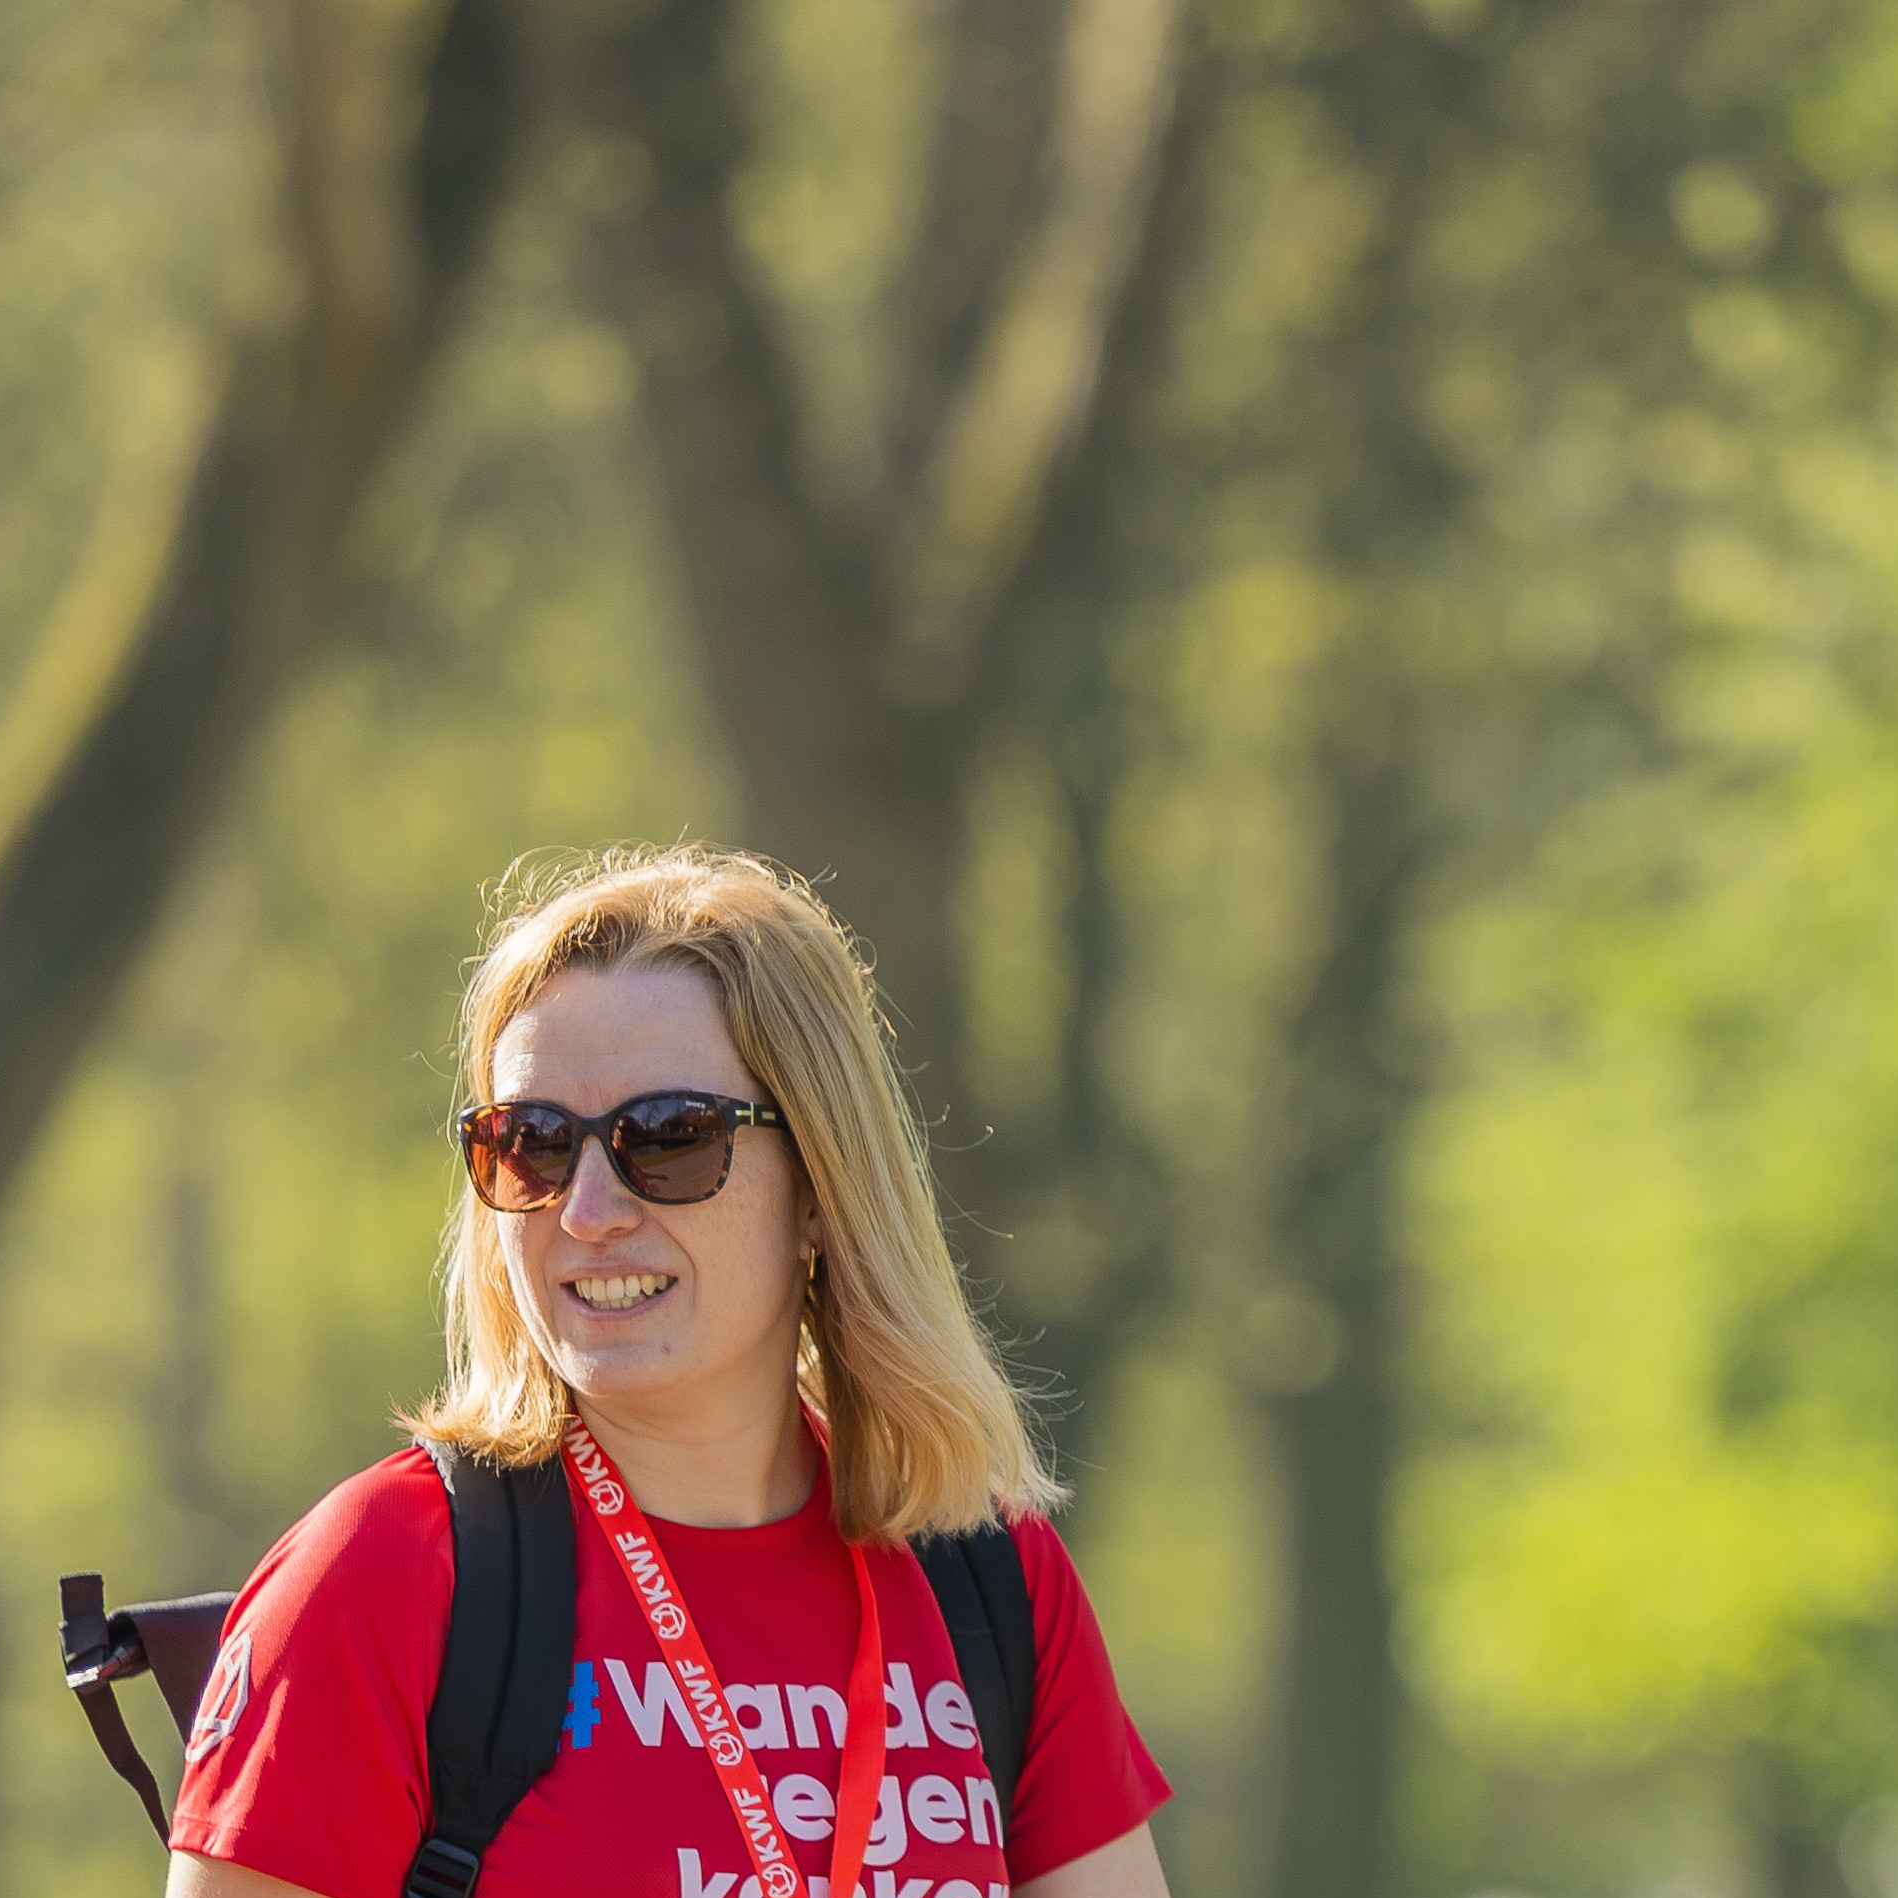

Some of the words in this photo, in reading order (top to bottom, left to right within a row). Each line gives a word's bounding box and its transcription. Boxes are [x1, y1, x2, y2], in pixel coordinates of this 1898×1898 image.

[614, 1531, 673, 1605] KWF
[556, 1657, 983, 1753] #Wande
[675, 1658, 730, 1733] KWF
[732, 1786, 785, 1863] KWF
[758, 1772, 1004, 1867] egen
